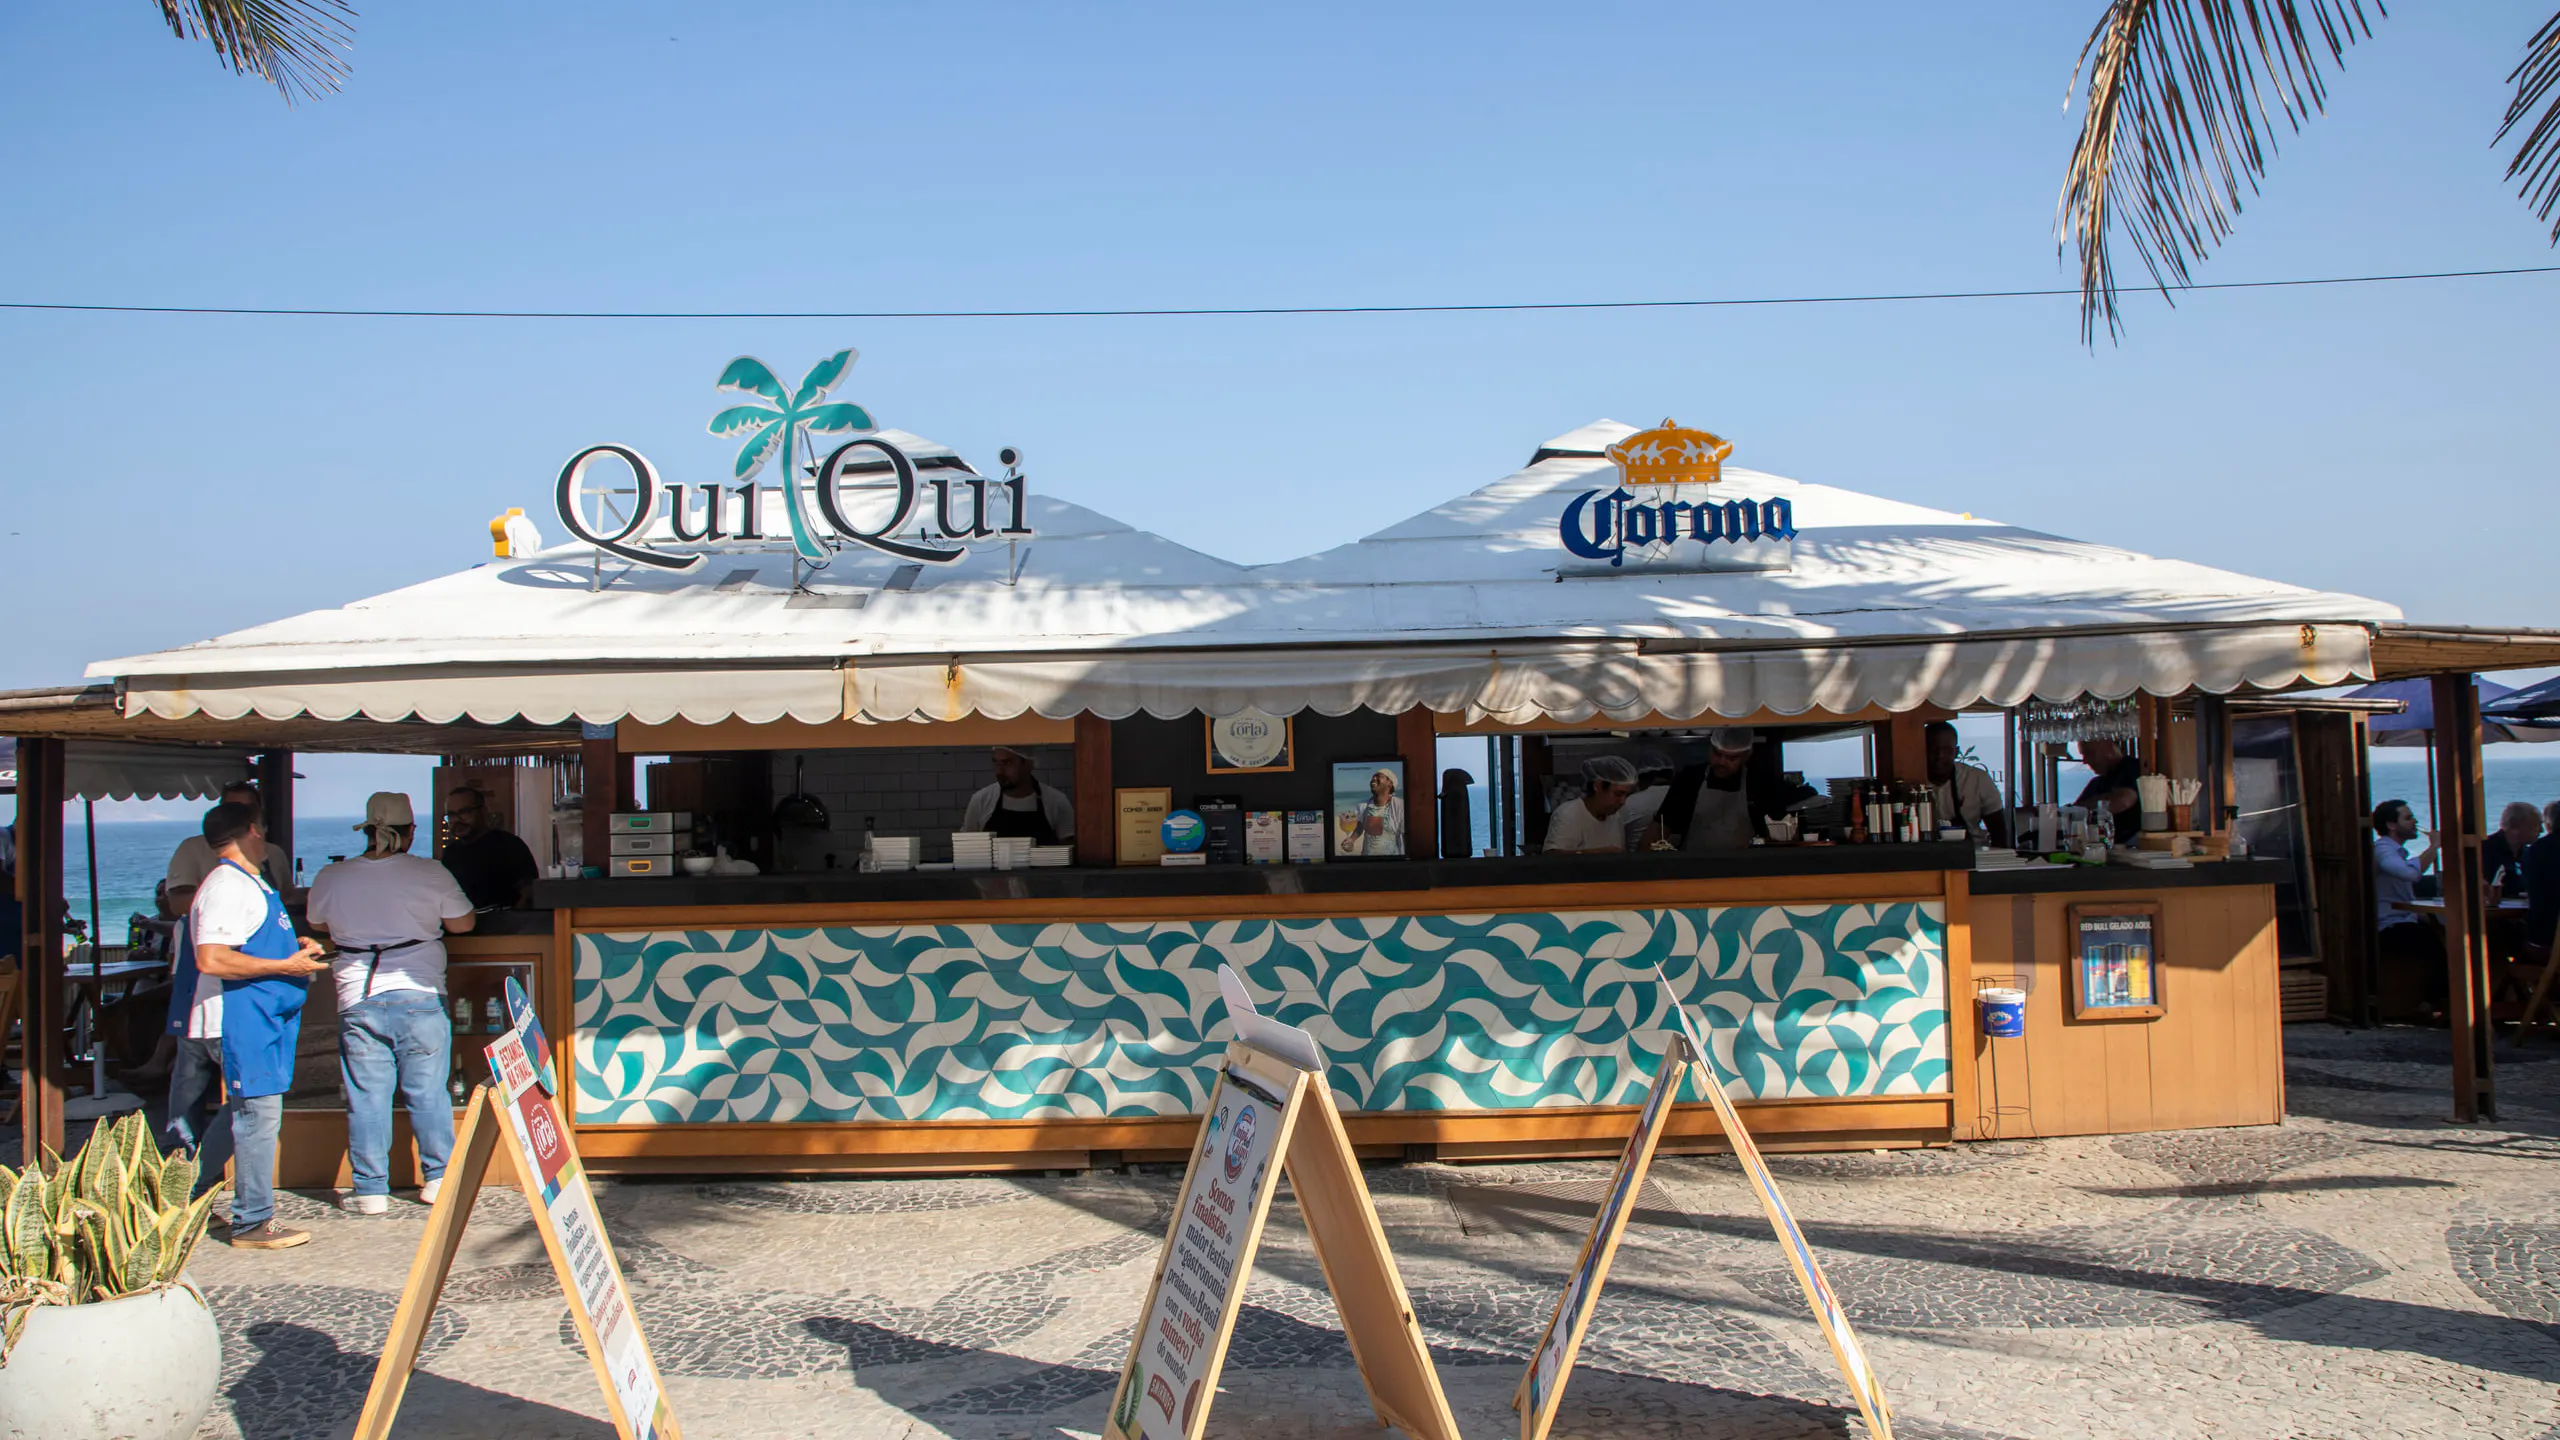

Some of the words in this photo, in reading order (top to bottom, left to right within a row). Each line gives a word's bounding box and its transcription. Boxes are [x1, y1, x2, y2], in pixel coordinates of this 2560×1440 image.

[553, 442, 766, 574] Qui
[815, 436, 1035, 567] Qui
[1559, 486, 1799, 567] Corona
[499, 1038, 525, 1070] ESTAMOS
[1191, 1194, 1228, 1240] finalistas
[1208, 1177, 1235, 1216] Somos
[1178, 1241, 1186, 1256] de
[1185, 1223, 1210, 1254] maior
[1206, 1239, 1234, 1279] festival
[1165, 1268, 1191, 1304] praiana
[1190, 1290, 1198, 1309] do
[1196, 1291, 1221, 1333] Brasil
[1181, 1249, 1227, 1305] gastronomia
[1156, 1338, 1166, 1357] do
[1160, 1316, 1191, 1361] número
[1165, 1295, 1179, 1319] com
[1176, 1311, 1183, 1324] a
[1181, 1311, 1205, 1350] vodka
